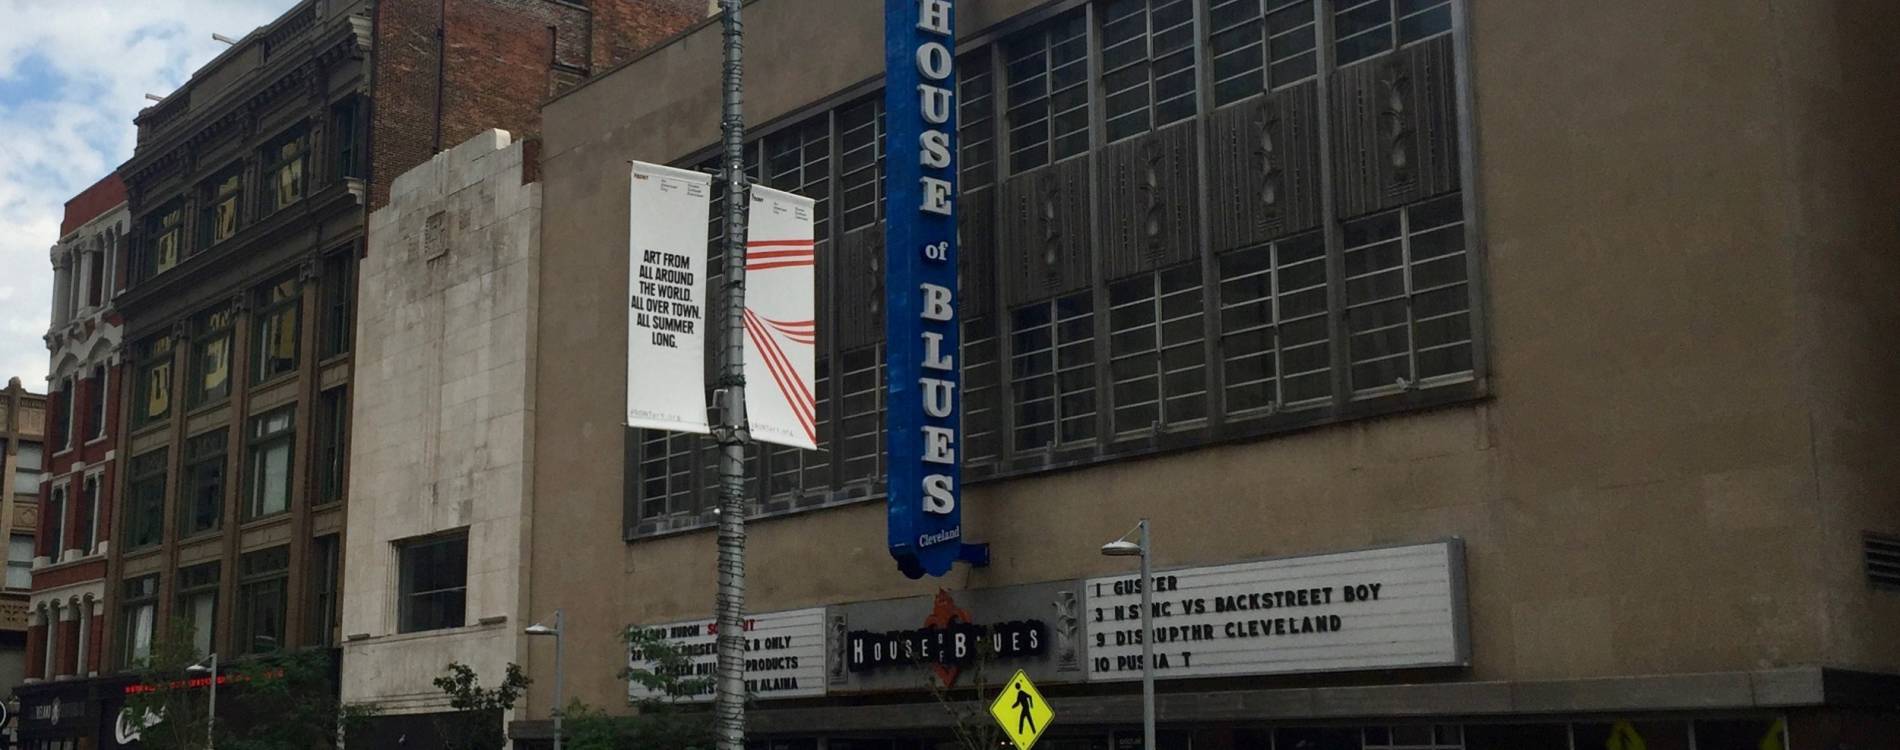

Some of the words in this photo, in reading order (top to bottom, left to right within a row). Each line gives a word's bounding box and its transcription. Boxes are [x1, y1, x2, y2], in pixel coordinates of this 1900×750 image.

[916, 0, 953, 216] HOUSE
[643, 249, 661, 265] ART
[663, 252, 690, 269] FROM
[925, 241, 949, 261] of
[639, 265, 653, 279] ALL
[655, 267, 694, 286] AROUND
[639, 281, 656, 296] THE
[657, 284, 692, 302] WORLD.
[631, 295, 644, 310] ALL
[646, 298, 669, 314] OVER
[672, 302, 702, 319] TOWN.
[637, 313, 650, 328] ALL
[652, 315, 694, 334] SUMMER
[652, 331, 678, 348] LONG.
[919, 282, 955, 514] BLUES
[919, 526, 960, 548] Cleveland
[1114, 576, 1177, 595] GUSER
[1095, 608, 1103, 622] 3
[1183, 599, 1205, 615] VS
[1215, 587, 1333, 613] BACKSTREET
[1343, 583, 1382, 603] BOY
[671, 624, 700, 638] HURON
[1096, 633, 1105, 647] 9
[1116, 624, 1214, 645] DISUPTHR
[1225, 614, 1342, 639] CLEVELAND
[765, 636, 791, 650] ONLY
[854, 638, 929, 664] HOUSE
[955, 629, 1038, 658] BUES
[746, 656, 798, 672] PRODUCTS
[1095, 657, 1110, 672] 10
[1117, 653, 1169, 671] PUSA
[1182, 652, 1192, 667] T
[760, 676, 799, 691] ALAINA
